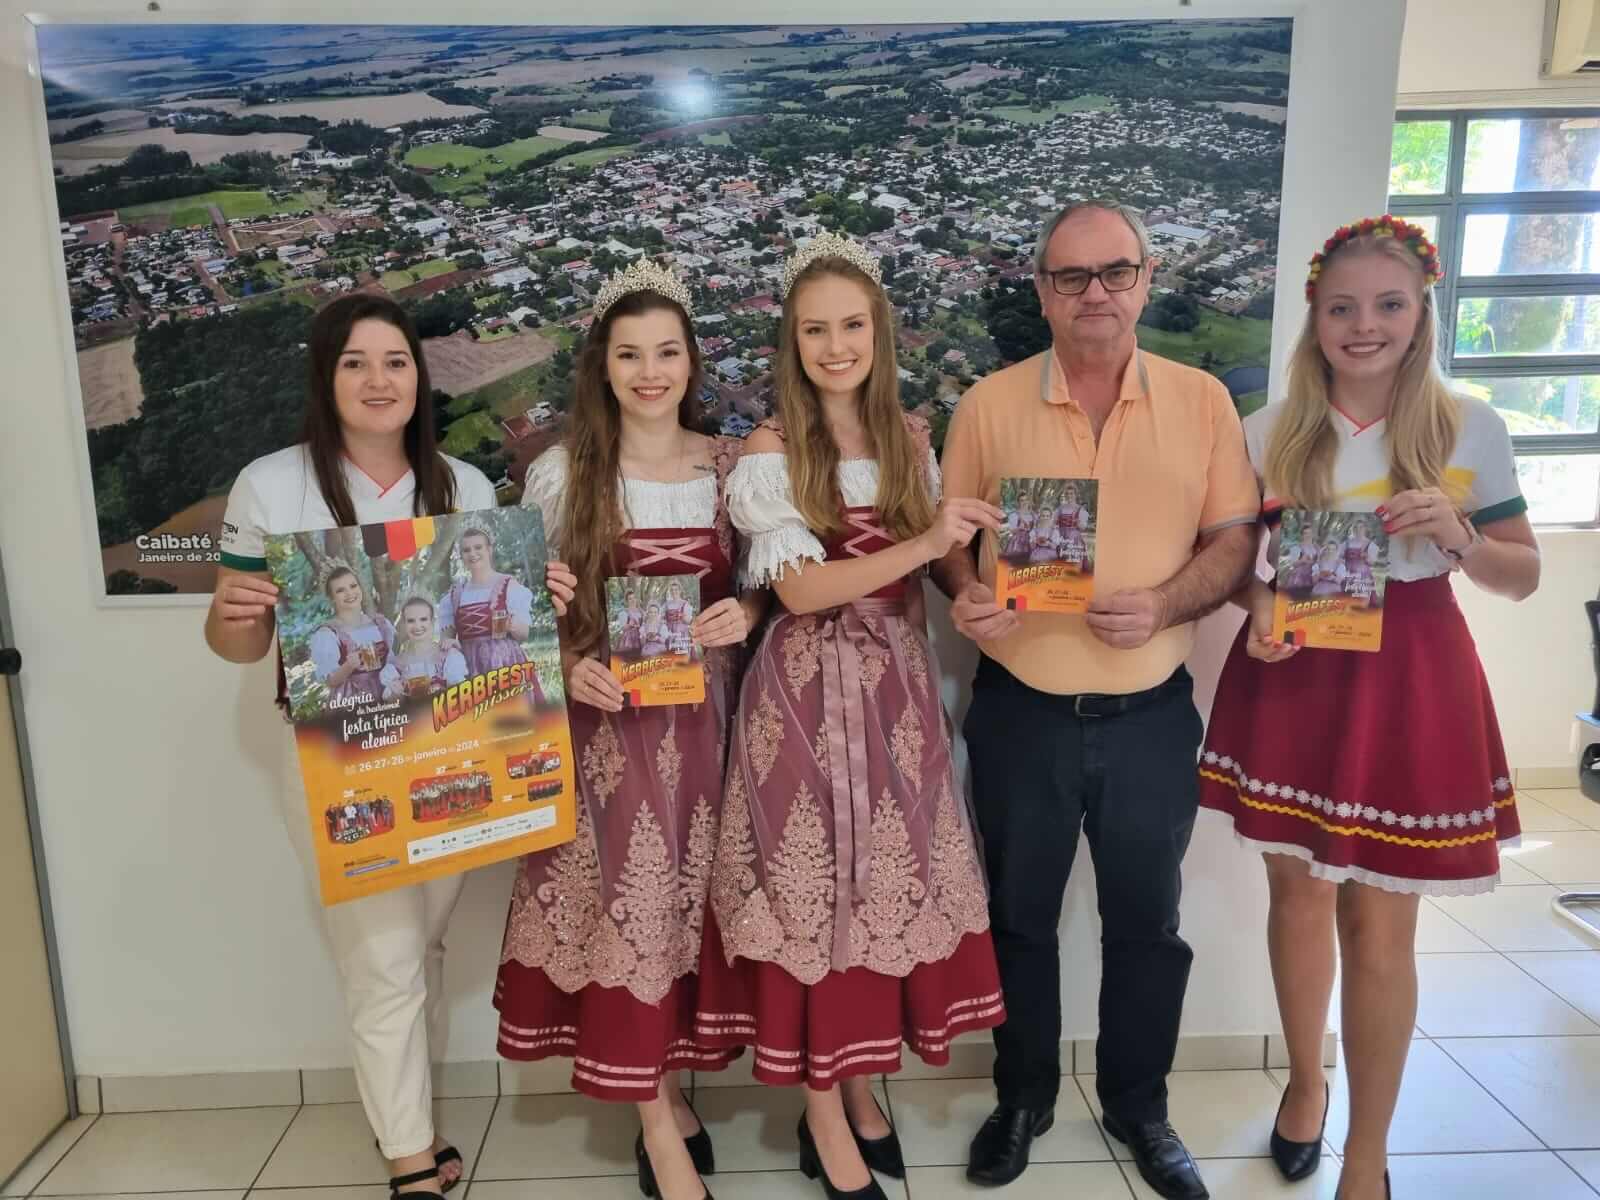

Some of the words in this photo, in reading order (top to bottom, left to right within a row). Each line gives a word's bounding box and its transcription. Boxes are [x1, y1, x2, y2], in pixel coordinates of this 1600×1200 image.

[136, 534, 212, 549] Caibaté
[139, 552, 184, 562] Janeiro
[187, 552, 202, 562] de
[329, 690, 375, 712] alegria
[432, 661, 535, 733] KERBFEST
[343, 717, 373, 743] festa
[374, 713, 409, 733] típica
